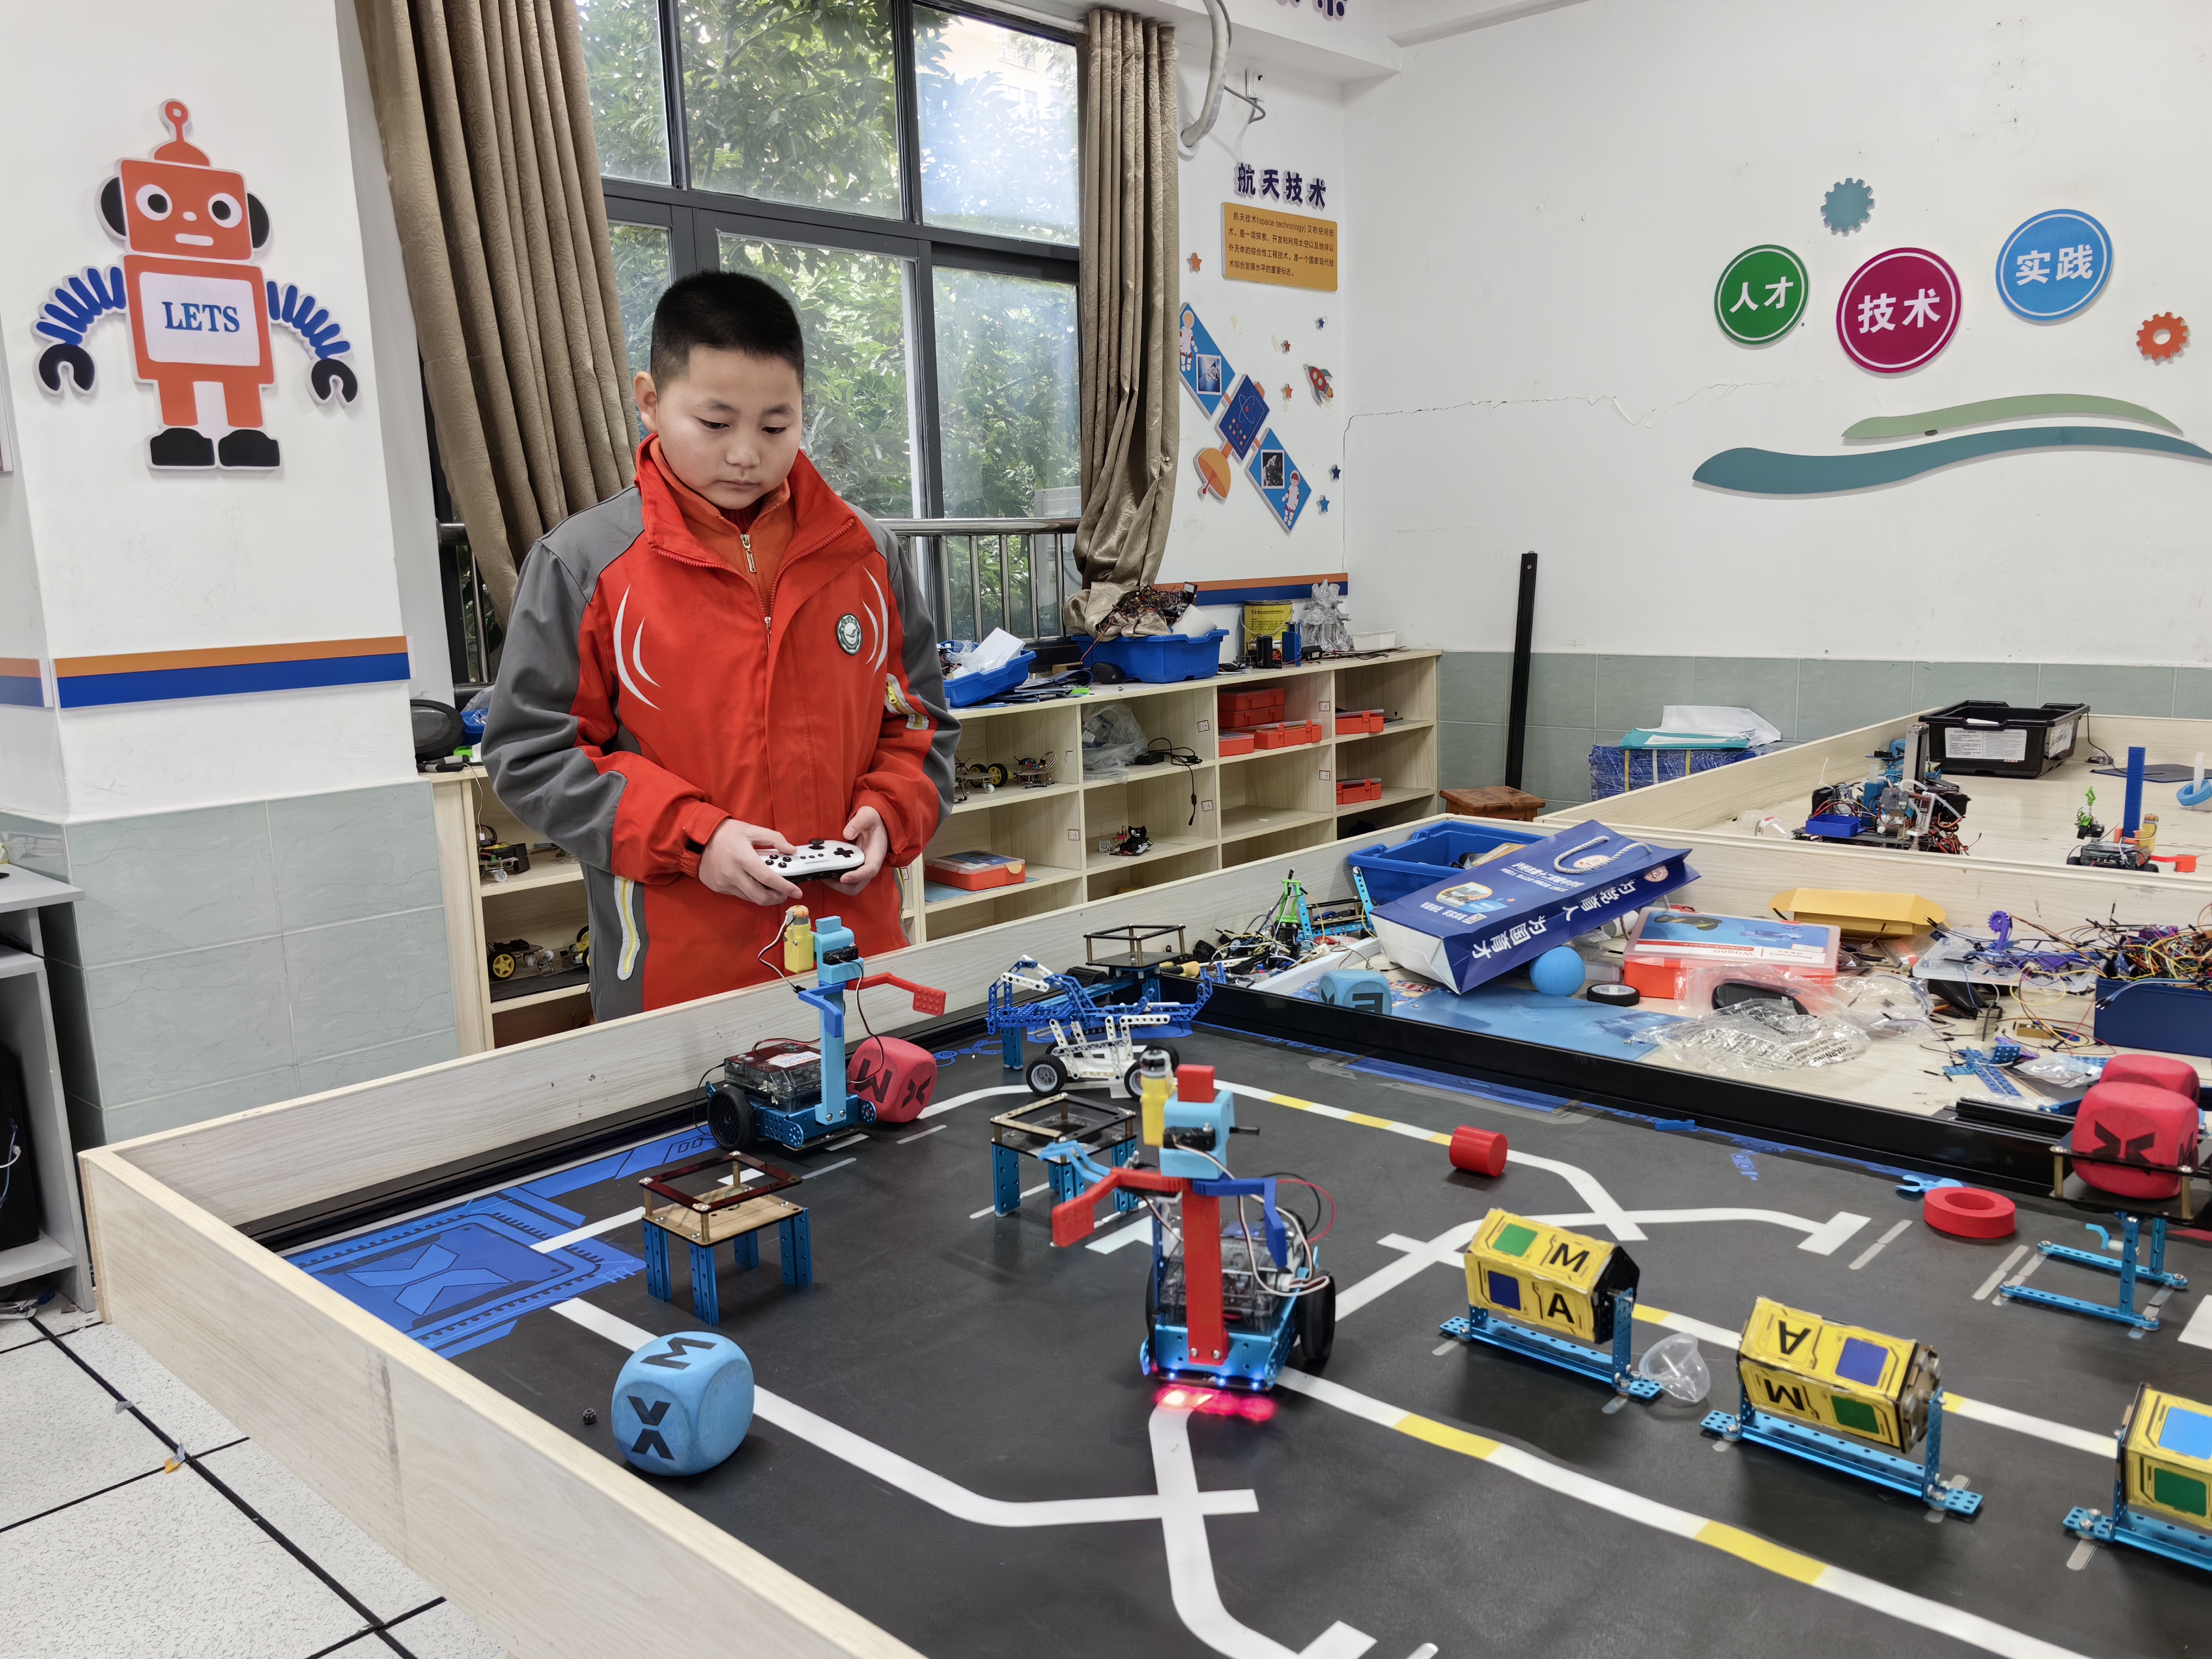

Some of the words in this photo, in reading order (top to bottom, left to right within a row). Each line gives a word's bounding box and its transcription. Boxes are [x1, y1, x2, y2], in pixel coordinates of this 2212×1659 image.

[1237, 163, 1327, 209] 航天技术
[2015, 244, 2094, 287] 实践
[1729, 276, 1794, 315] 人才
[1857, 288, 1942, 335] 技术
[162, 301, 239, 332] LETS
[1562, 879, 1636, 921] 为党育人
[1471, 915, 1547, 959] 为国育才
[1548, 1243, 1591, 1273] M
[1547, 1293, 1575, 1324] A
[1777, 1321, 1811, 1355] A
